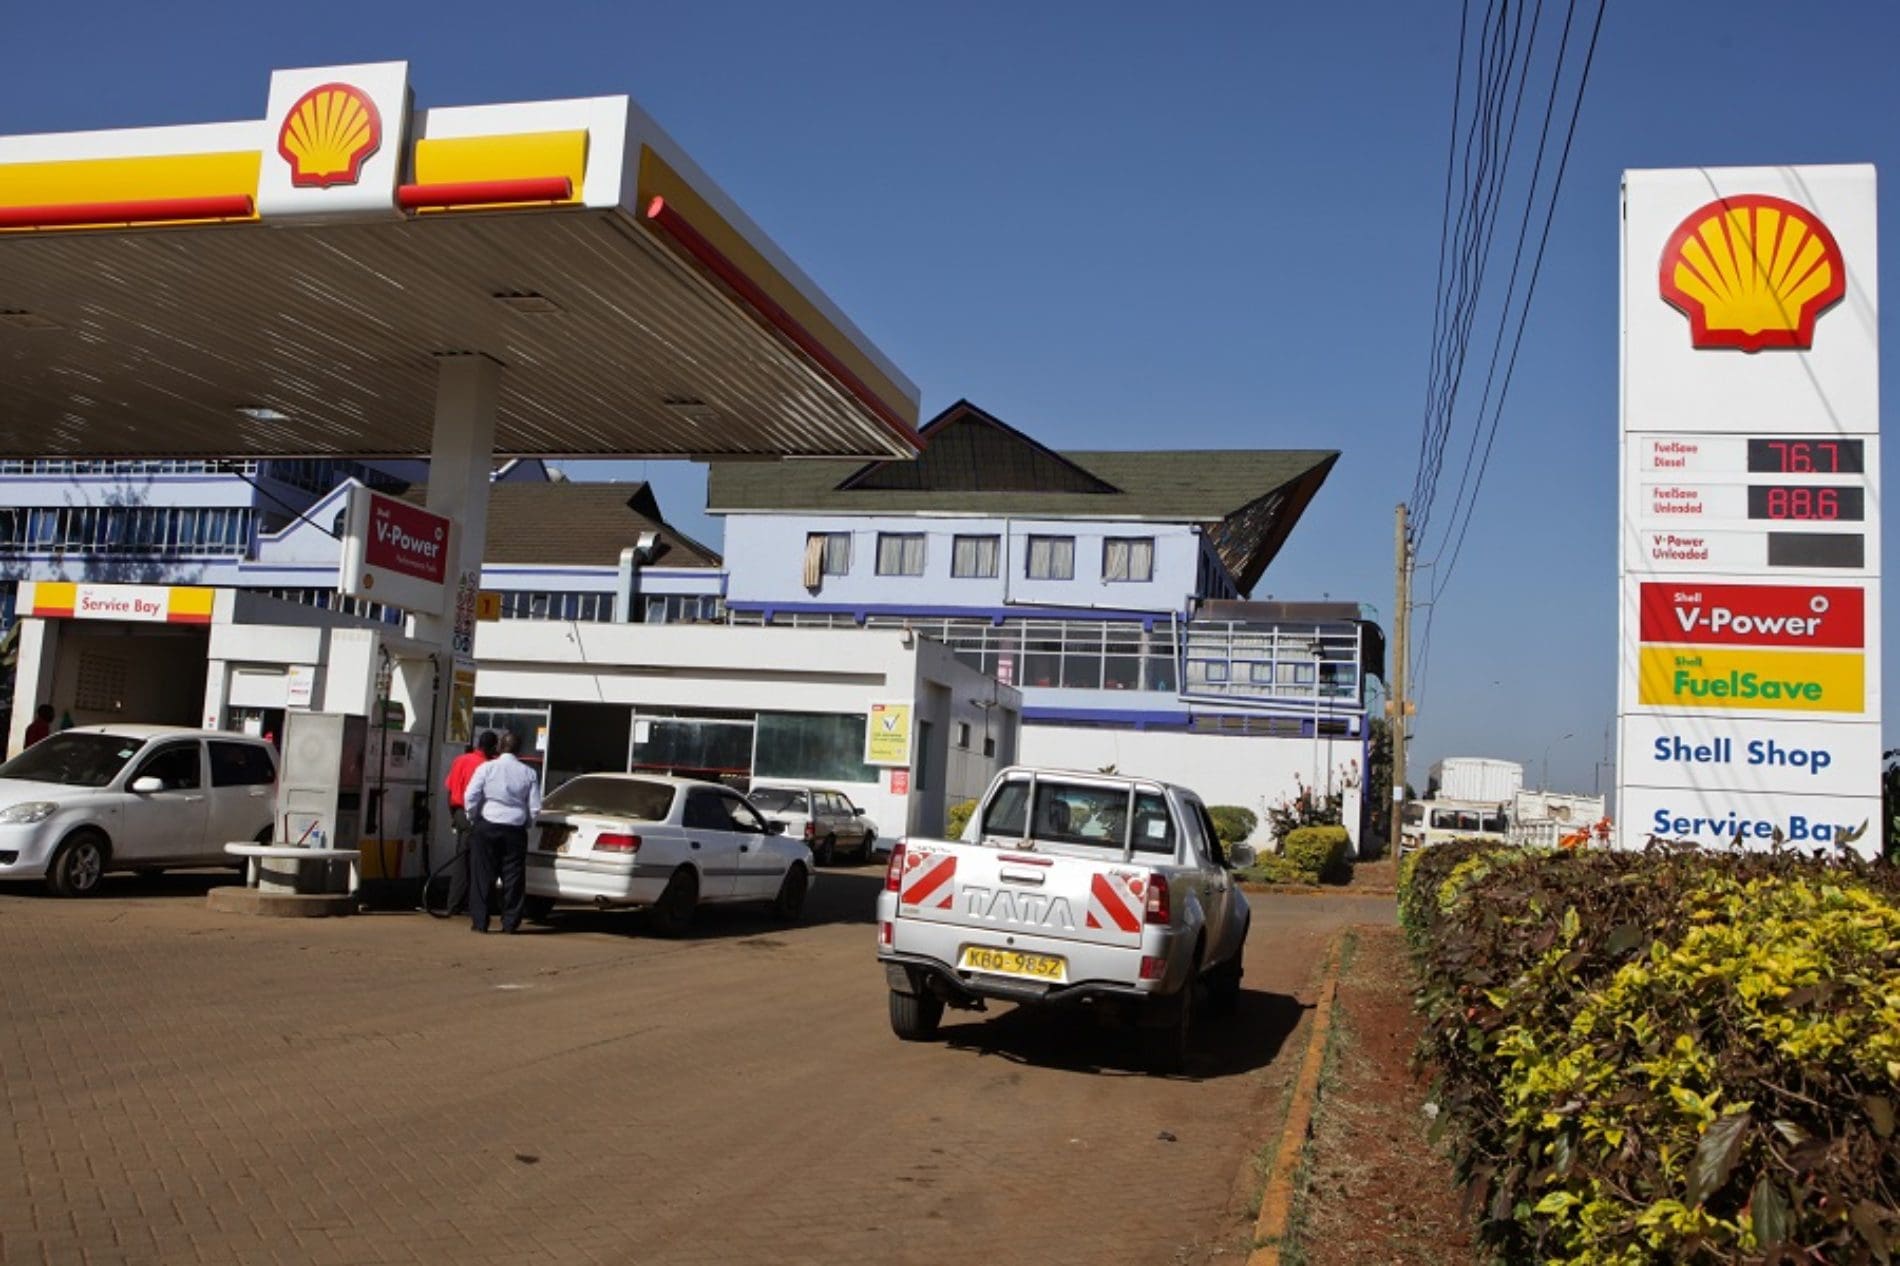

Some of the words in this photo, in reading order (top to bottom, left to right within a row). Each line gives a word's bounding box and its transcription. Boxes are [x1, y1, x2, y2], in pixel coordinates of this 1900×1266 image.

[1654, 442, 1698, 453] FuelSave
[1768, 442, 1838, 472] 76.7
[1654, 457, 1685, 467] Diesel
[1654, 487, 1698, 499] FuelSave
[1768, 488, 1838, 519] 88.6
[1654, 502, 1702, 513] Unleaded
[376, 519, 439, 558] V-Power
[1653, 535, 1704, 547] V-Power
[1653, 548, 1708, 560] Unleaded
[82, 597, 129, 611] Service
[134, 599, 161, 616] Bay
[1674, 592, 1702, 603] Shell
[1674, 607, 1821, 636] V-Power
[1674, 670, 1822, 700] FuelSave
[1654, 736, 1730, 763] Shell
[1748, 740, 1831, 774] Shop
[1653, 810, 1772, 838] Service
[962, 884, 1075, 931] TATA
[1015, 953, 1060, 976] 985Z
